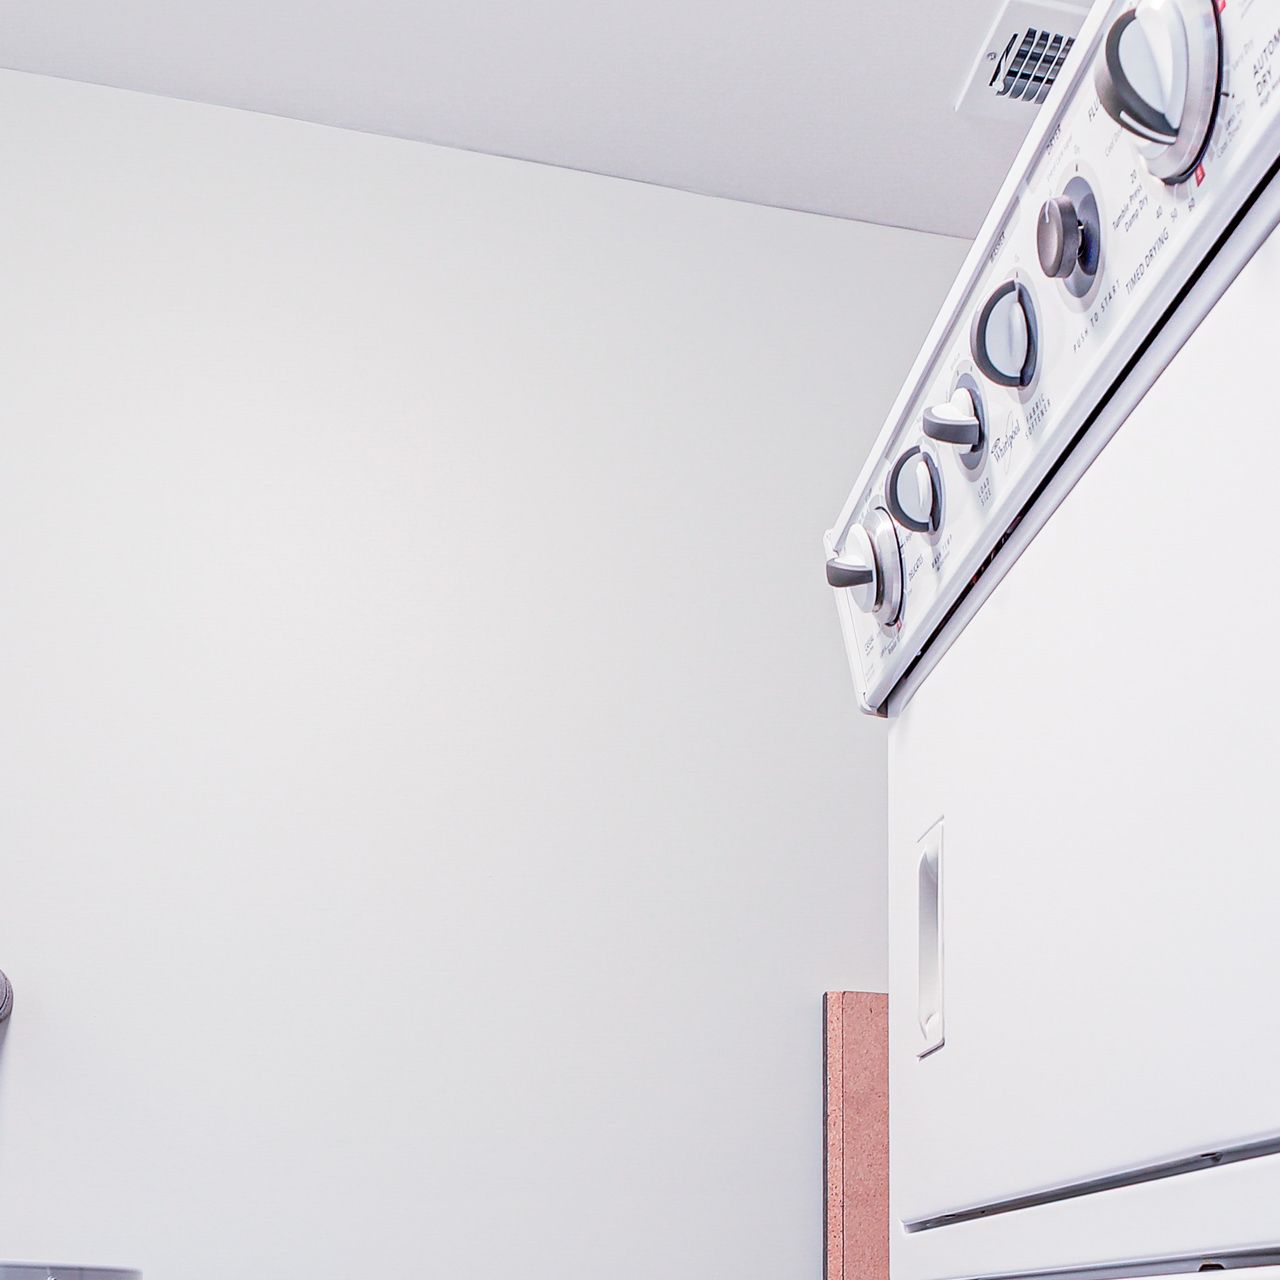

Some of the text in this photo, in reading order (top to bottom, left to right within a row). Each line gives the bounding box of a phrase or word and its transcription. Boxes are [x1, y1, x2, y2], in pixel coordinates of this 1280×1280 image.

[1256, 65, 1272, 97] DRY
[1125, 226, 1170, 296] TIMED DRYING
[1073, 280, 1121, 353] PUSH TO START
